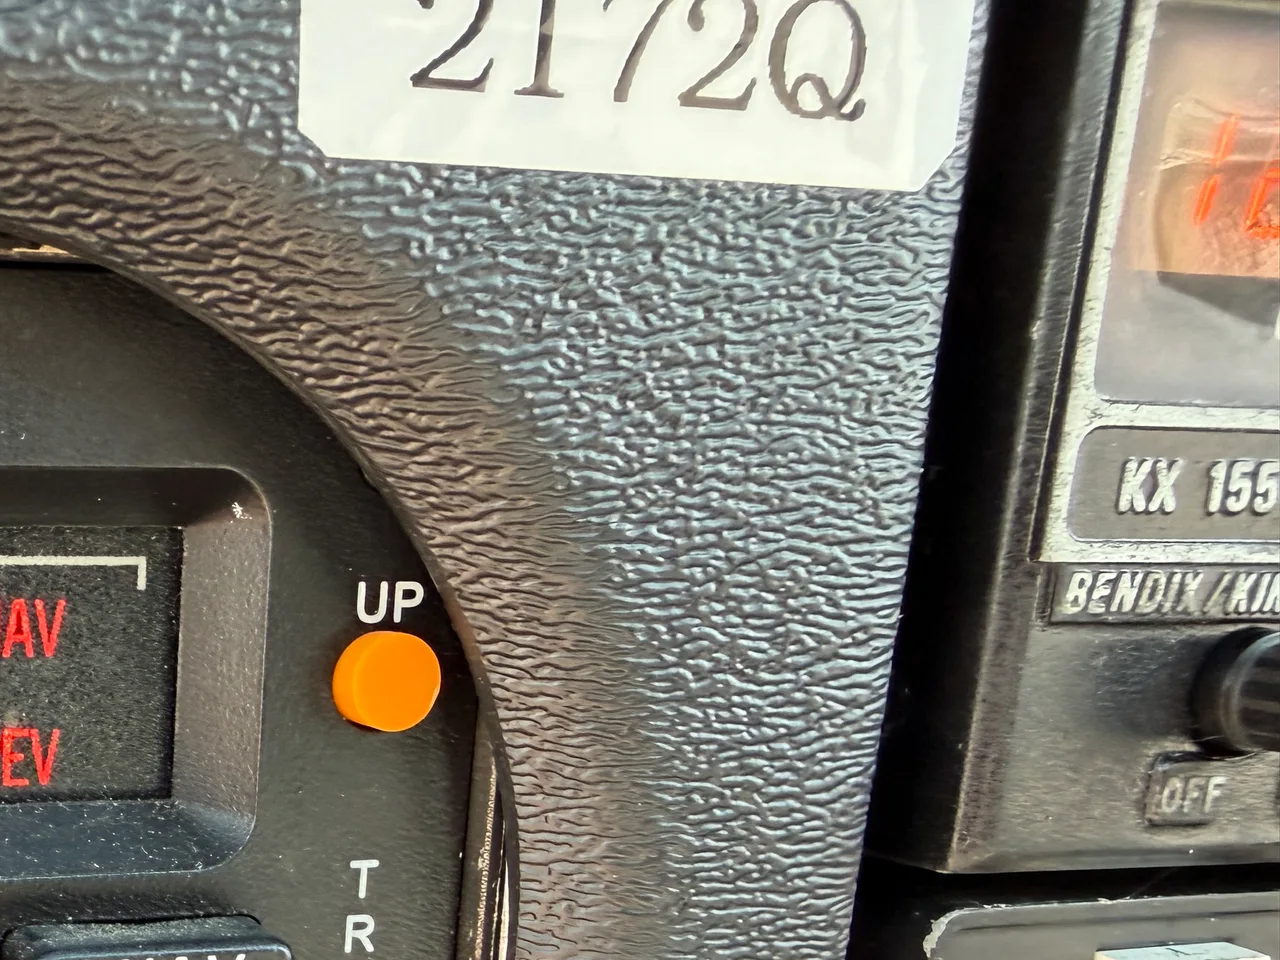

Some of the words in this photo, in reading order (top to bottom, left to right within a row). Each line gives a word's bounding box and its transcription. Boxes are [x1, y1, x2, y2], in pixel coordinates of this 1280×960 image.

[410, 0, 868, 121] 2172Q
[1118, 457, 1185, 513] KX
[1206, 457, 1280, 514] 155
[356, 580, 425, 624] UP
[1161, 776, 1228, 815] OFF
